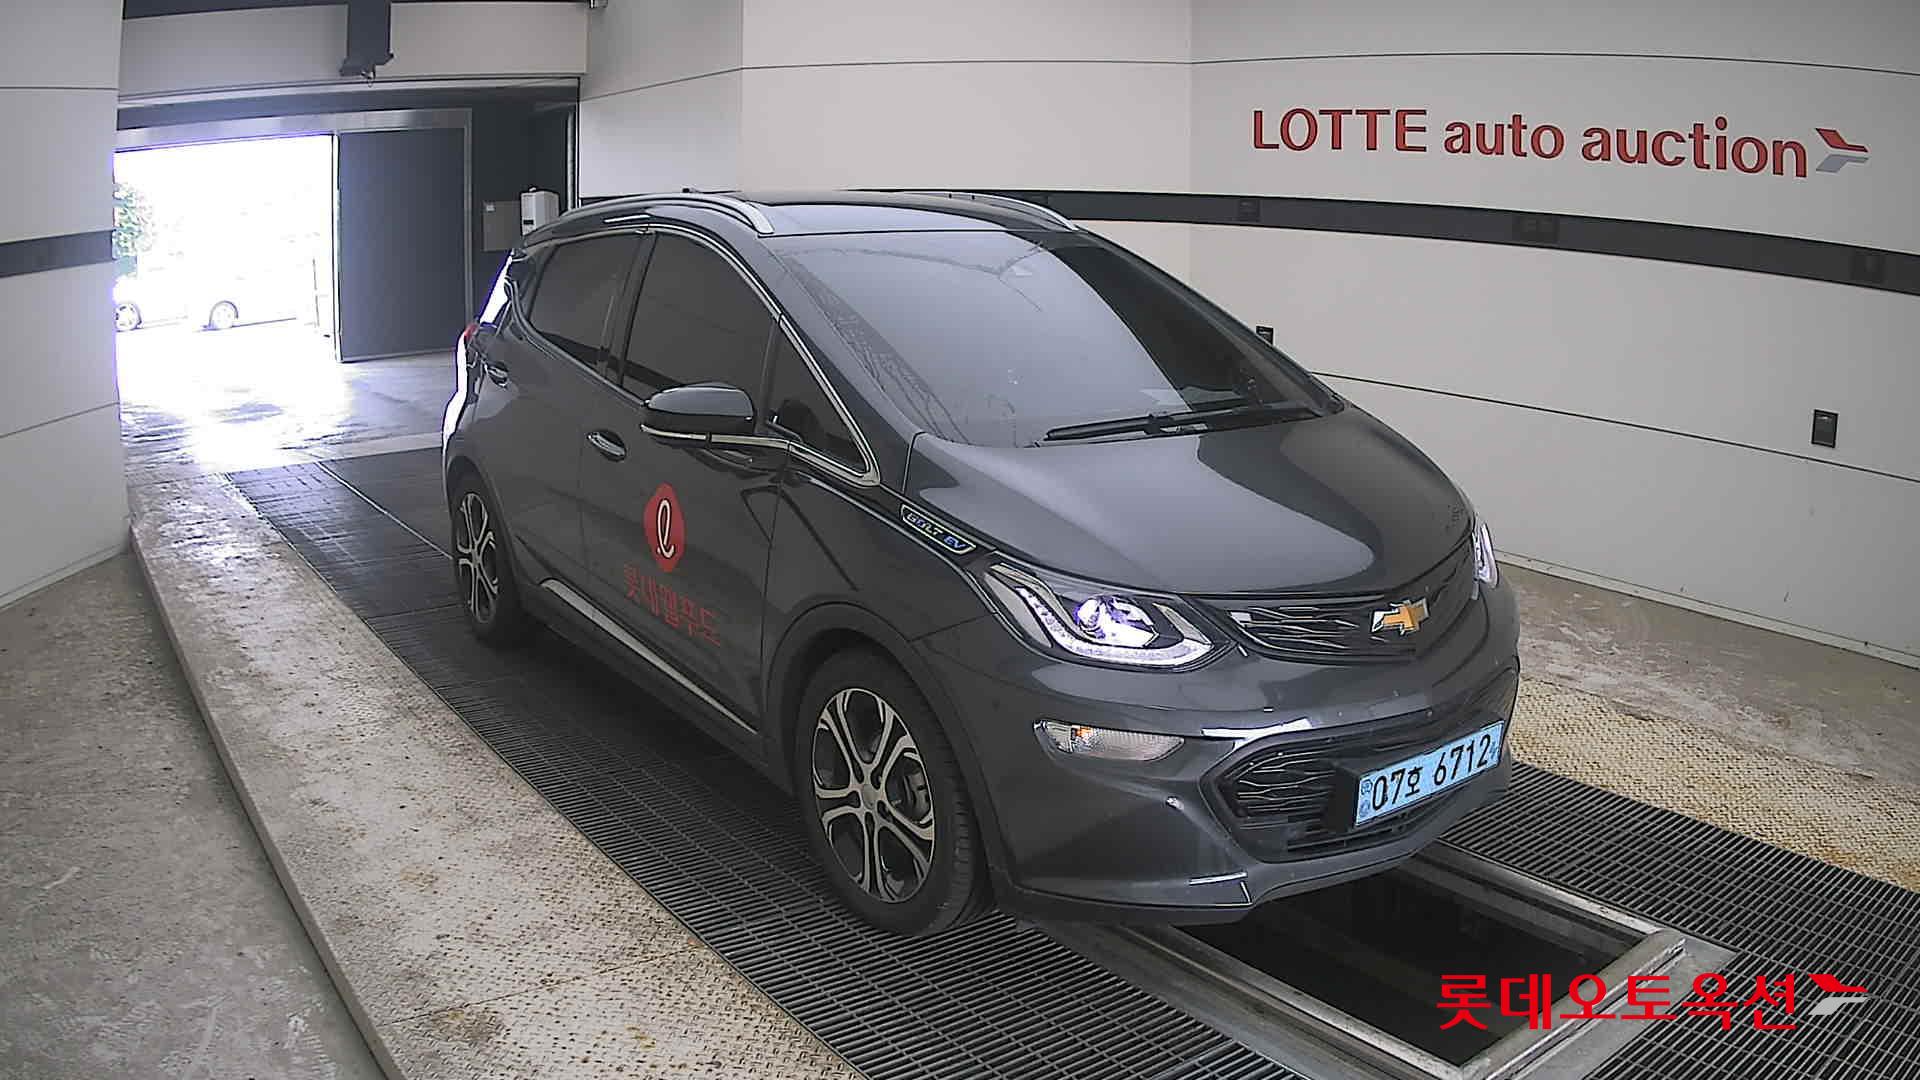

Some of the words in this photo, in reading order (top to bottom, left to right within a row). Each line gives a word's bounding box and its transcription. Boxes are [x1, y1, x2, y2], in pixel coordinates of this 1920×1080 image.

[1253, 107, 1427, 153] LOTTE
[1443, 114, 1566, 160] auto
[1582, 116, 1808, 178] auction
[906, 512, 943, 536] BOLT
[944, 535, 967, 549] EV
[1371, 766, 1424, 811] 07호
[1432, 733, 1492, 787] 6712
